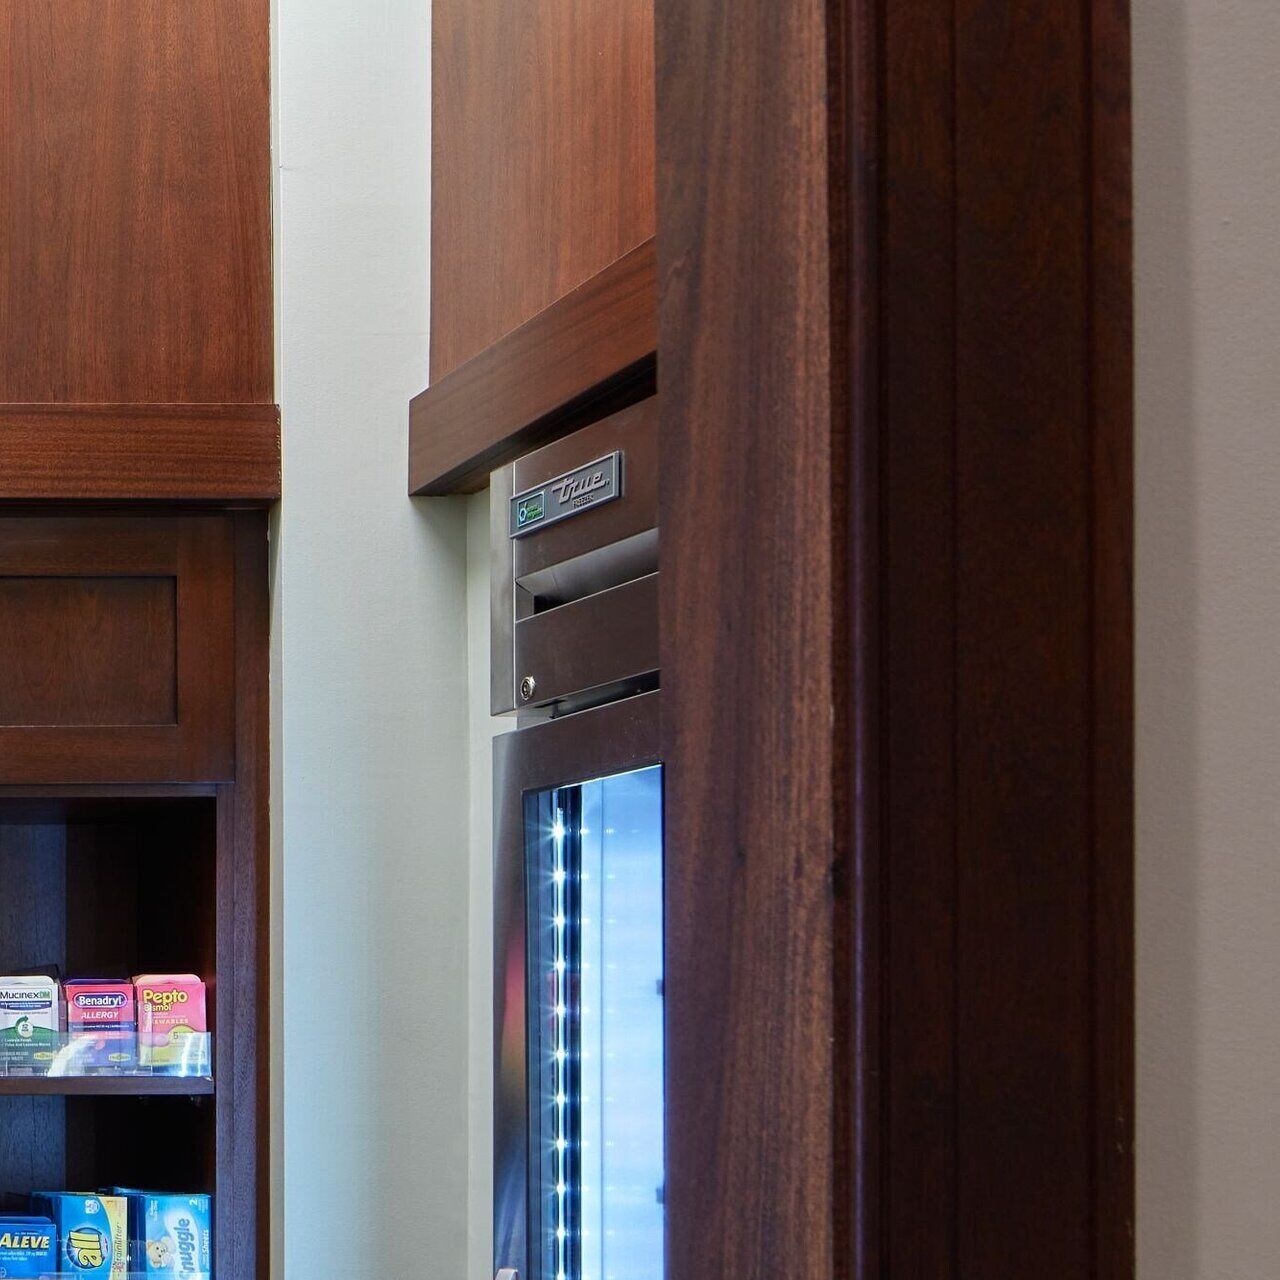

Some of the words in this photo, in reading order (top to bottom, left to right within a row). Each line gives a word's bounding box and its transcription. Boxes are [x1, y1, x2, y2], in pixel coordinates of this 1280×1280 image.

[79, 995, 122, 1006] Benadryl
[143, 989, 188, 1005] Pepto
[81, 1011, 119, 1019] ALLERGY
